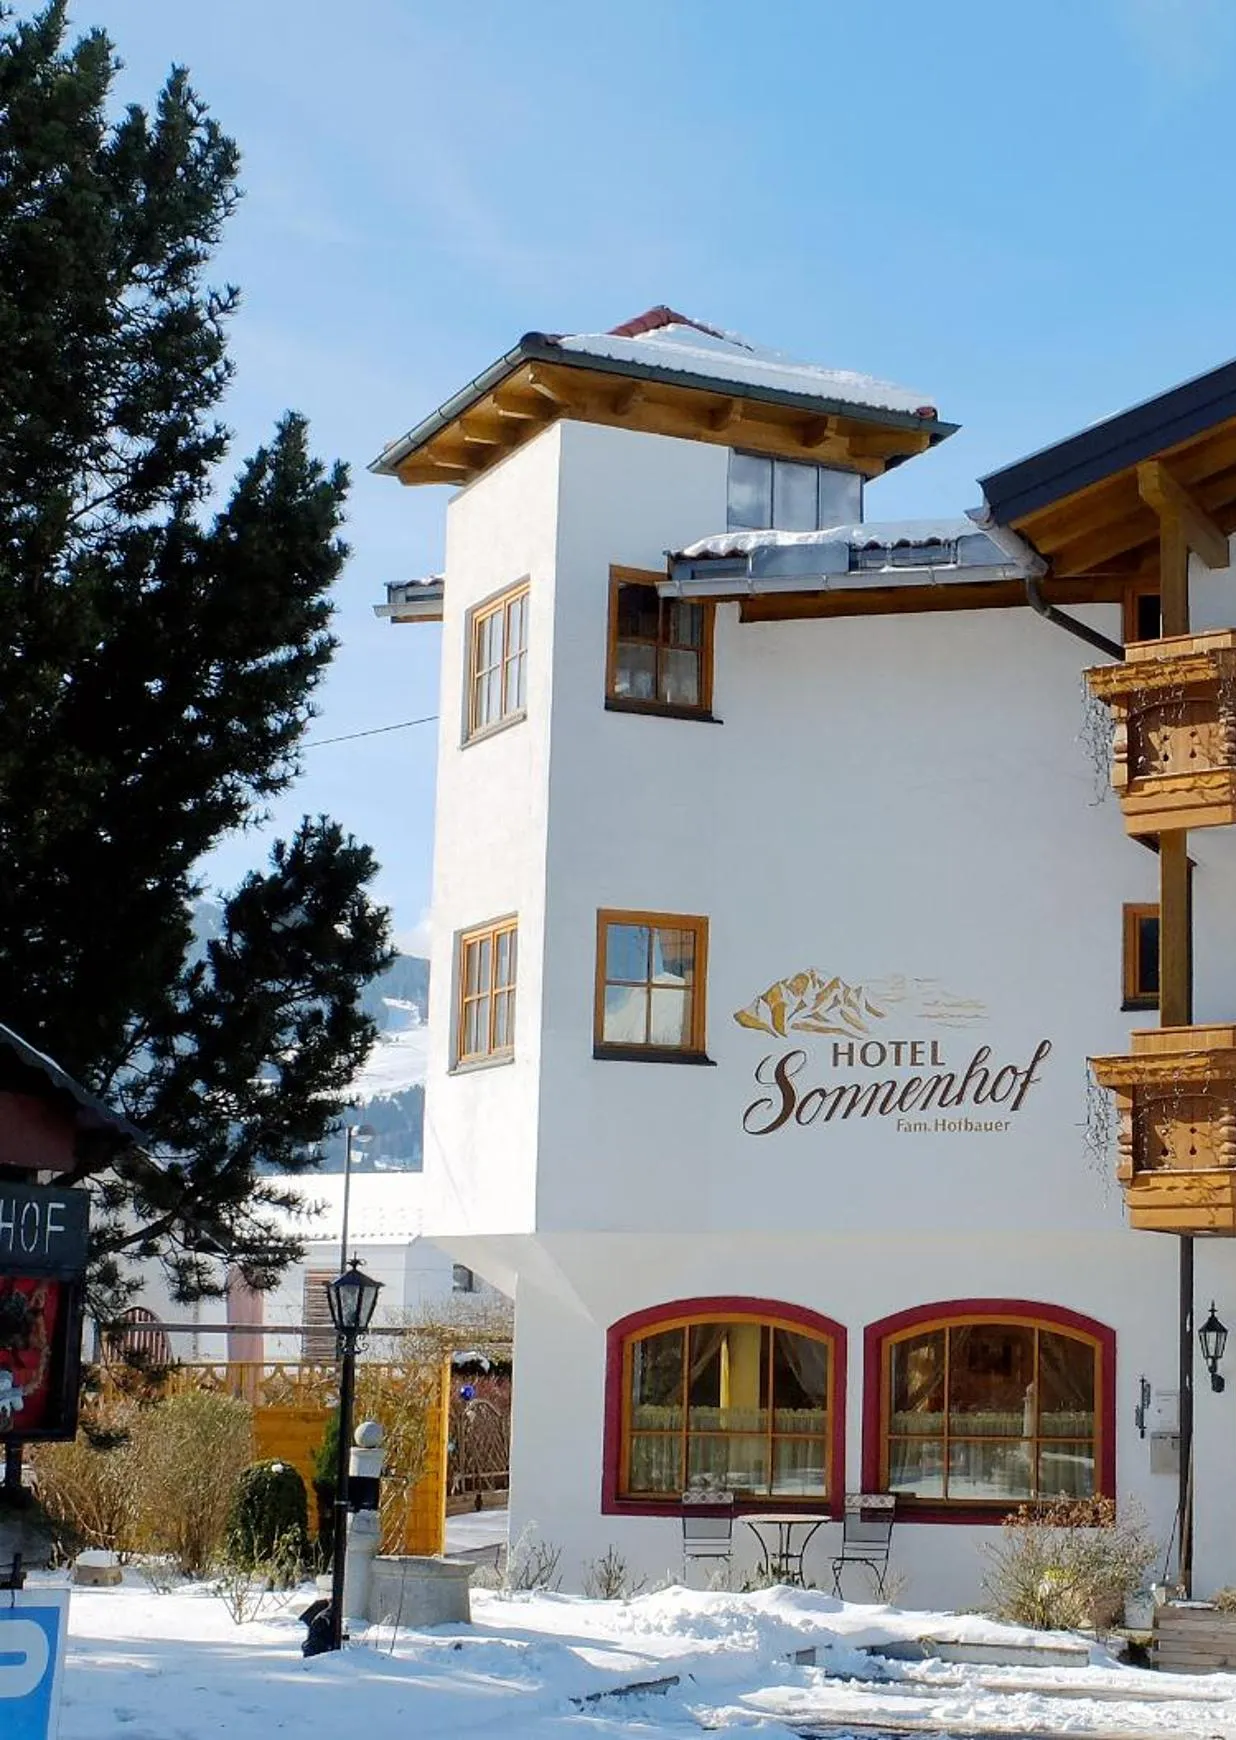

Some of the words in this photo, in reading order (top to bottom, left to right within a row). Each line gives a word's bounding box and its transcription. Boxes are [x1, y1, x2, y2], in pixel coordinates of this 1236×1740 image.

[832, 1040, 946, 1068] HOTEL
[742, 1038, 1053, 1136] Sonnenhof
[0, 1199, 67, 1254] HOF
